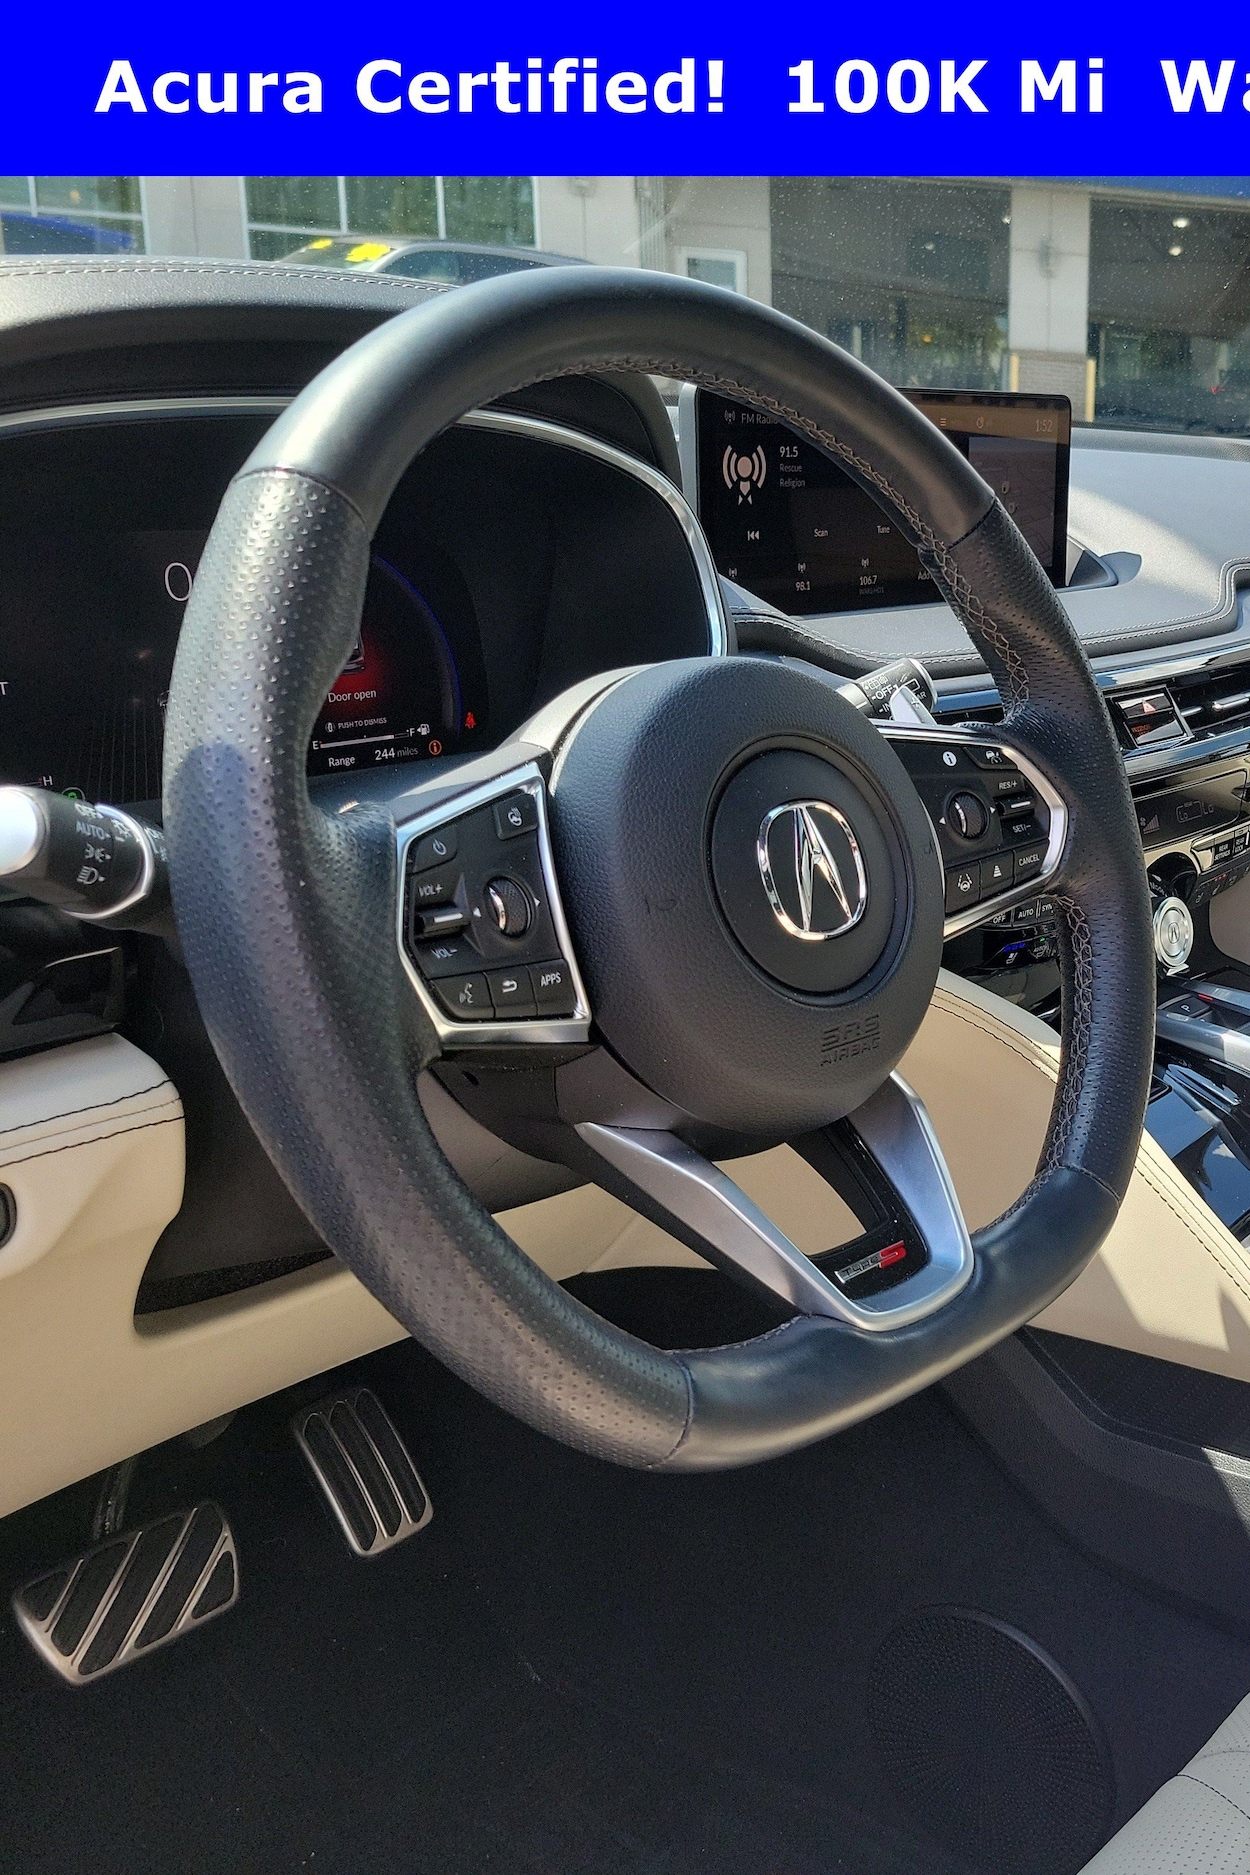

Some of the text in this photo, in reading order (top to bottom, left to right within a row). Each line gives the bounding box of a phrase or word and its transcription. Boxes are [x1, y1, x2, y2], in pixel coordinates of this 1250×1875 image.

[741, 413, 755, 424] FM
[1035, 419, 1053, 432] 1:52
[780, 446, 798, 458] 91.5
[780, 463, 802, 472] Rescue
[780, 479, 805, 489] Religion
[814, 528, 829, 537] Scan
[877, 525, 890, 534] Tune
[795, 581, 811, 591] 98.1
[860, 575, 878, 586] 106.7
[327, 689, 377, 703] Door open
[876, 684, 893, 700] OFF
[338, 721, 354, 730] PUSH
[364, 716, 388, 726] DISMISS
[409, 727, 415, 737] F
[312, 740, 319, 750] E
[328, 746, 419, 767] Range 244 miles
[42, 775, 53, 786] H
[76, 820, 105, 840] AUTO
[1018, 854, 1040, 866] CANCEL
[1018, 908, 1034, 918] AUTO
[992, 914, 1006, 924] OFF
[540, 972, 562, 987] APPS
[820, 1037, 881, 1067] AIRBAG
